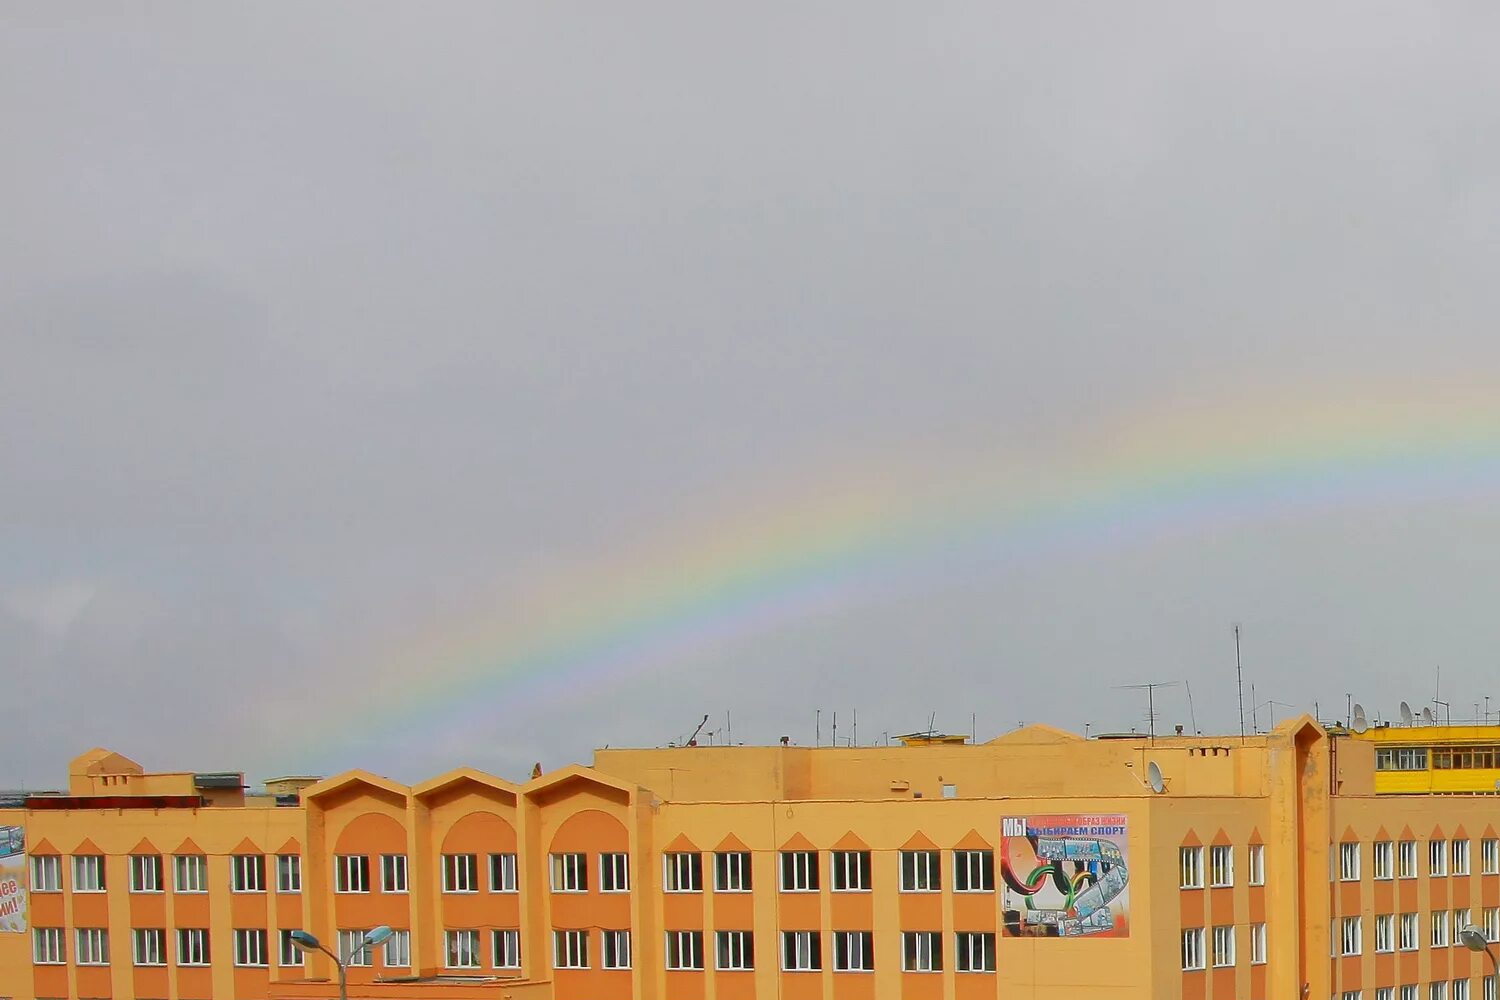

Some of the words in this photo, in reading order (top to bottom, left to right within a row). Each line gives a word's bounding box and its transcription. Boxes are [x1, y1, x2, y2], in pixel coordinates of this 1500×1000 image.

[1003, 818, 1026, 837] МЫ
[1027, 826, 1088, 836] ВЫБИРАЕМ
[1091, 826, 1125, 835] СПОРТ
[0, 880, 17, 897] ее
